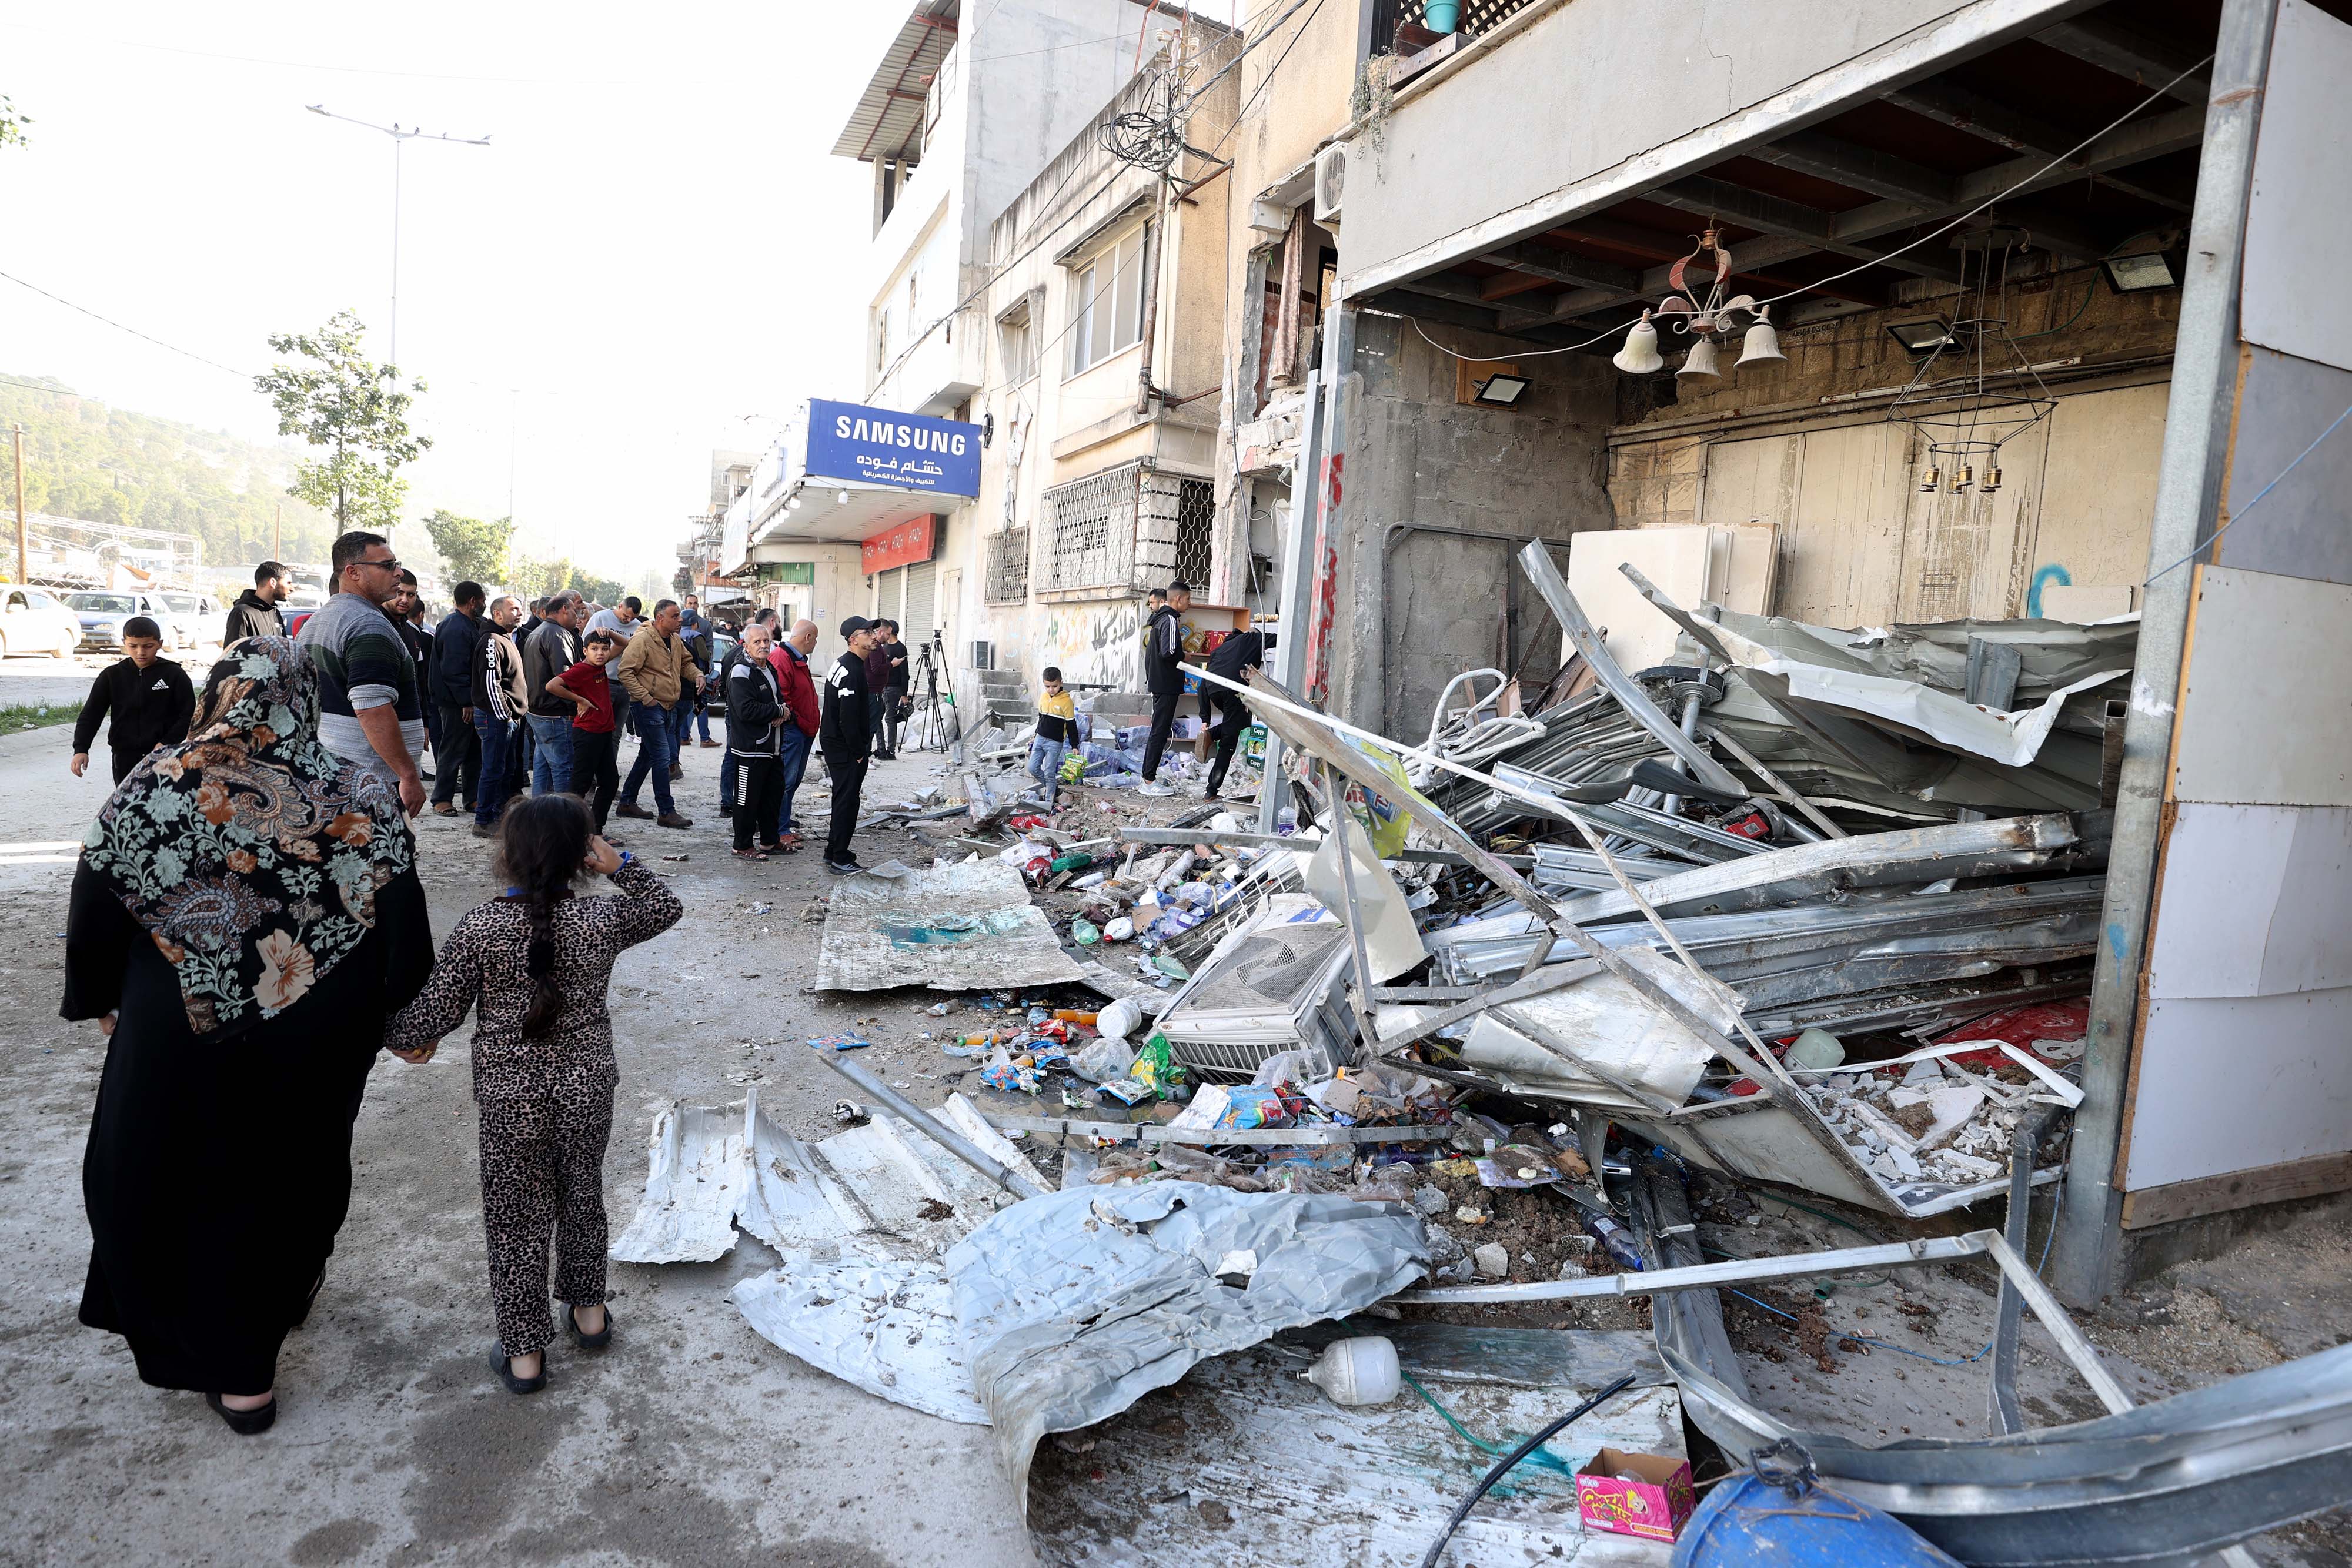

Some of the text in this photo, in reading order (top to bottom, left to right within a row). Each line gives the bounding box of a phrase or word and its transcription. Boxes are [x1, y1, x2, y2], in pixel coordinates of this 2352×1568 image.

[836, 415, 965, 456] SAMSUNG
[900, 460, 943, 476] حسام
[486, 638, 495, 668] adidas
[1254, 727, 1265, 735] Cappy
[1250, 759, 1261, 768] Cappy
